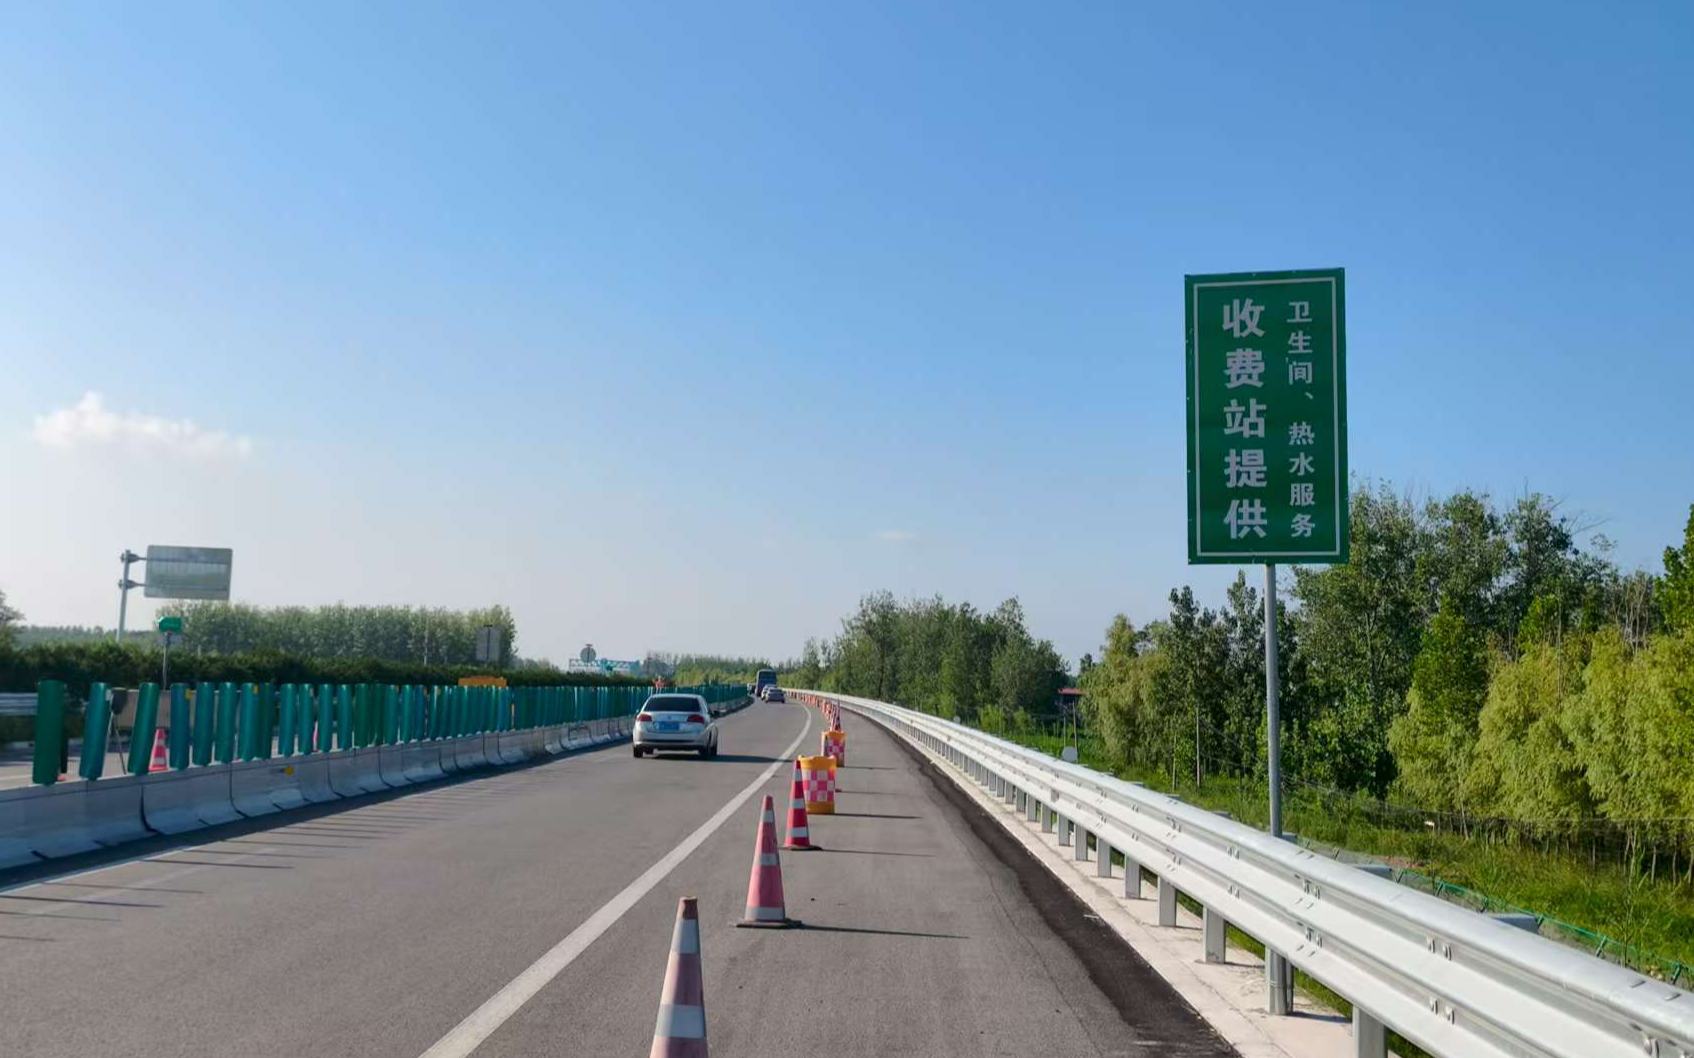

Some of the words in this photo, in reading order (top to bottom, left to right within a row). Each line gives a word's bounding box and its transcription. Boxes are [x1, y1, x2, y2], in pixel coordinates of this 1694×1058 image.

[1222, 298, 1268, 540] 收费站提供
[1286, 301, 1316, 539] 卫生间、热水服务
